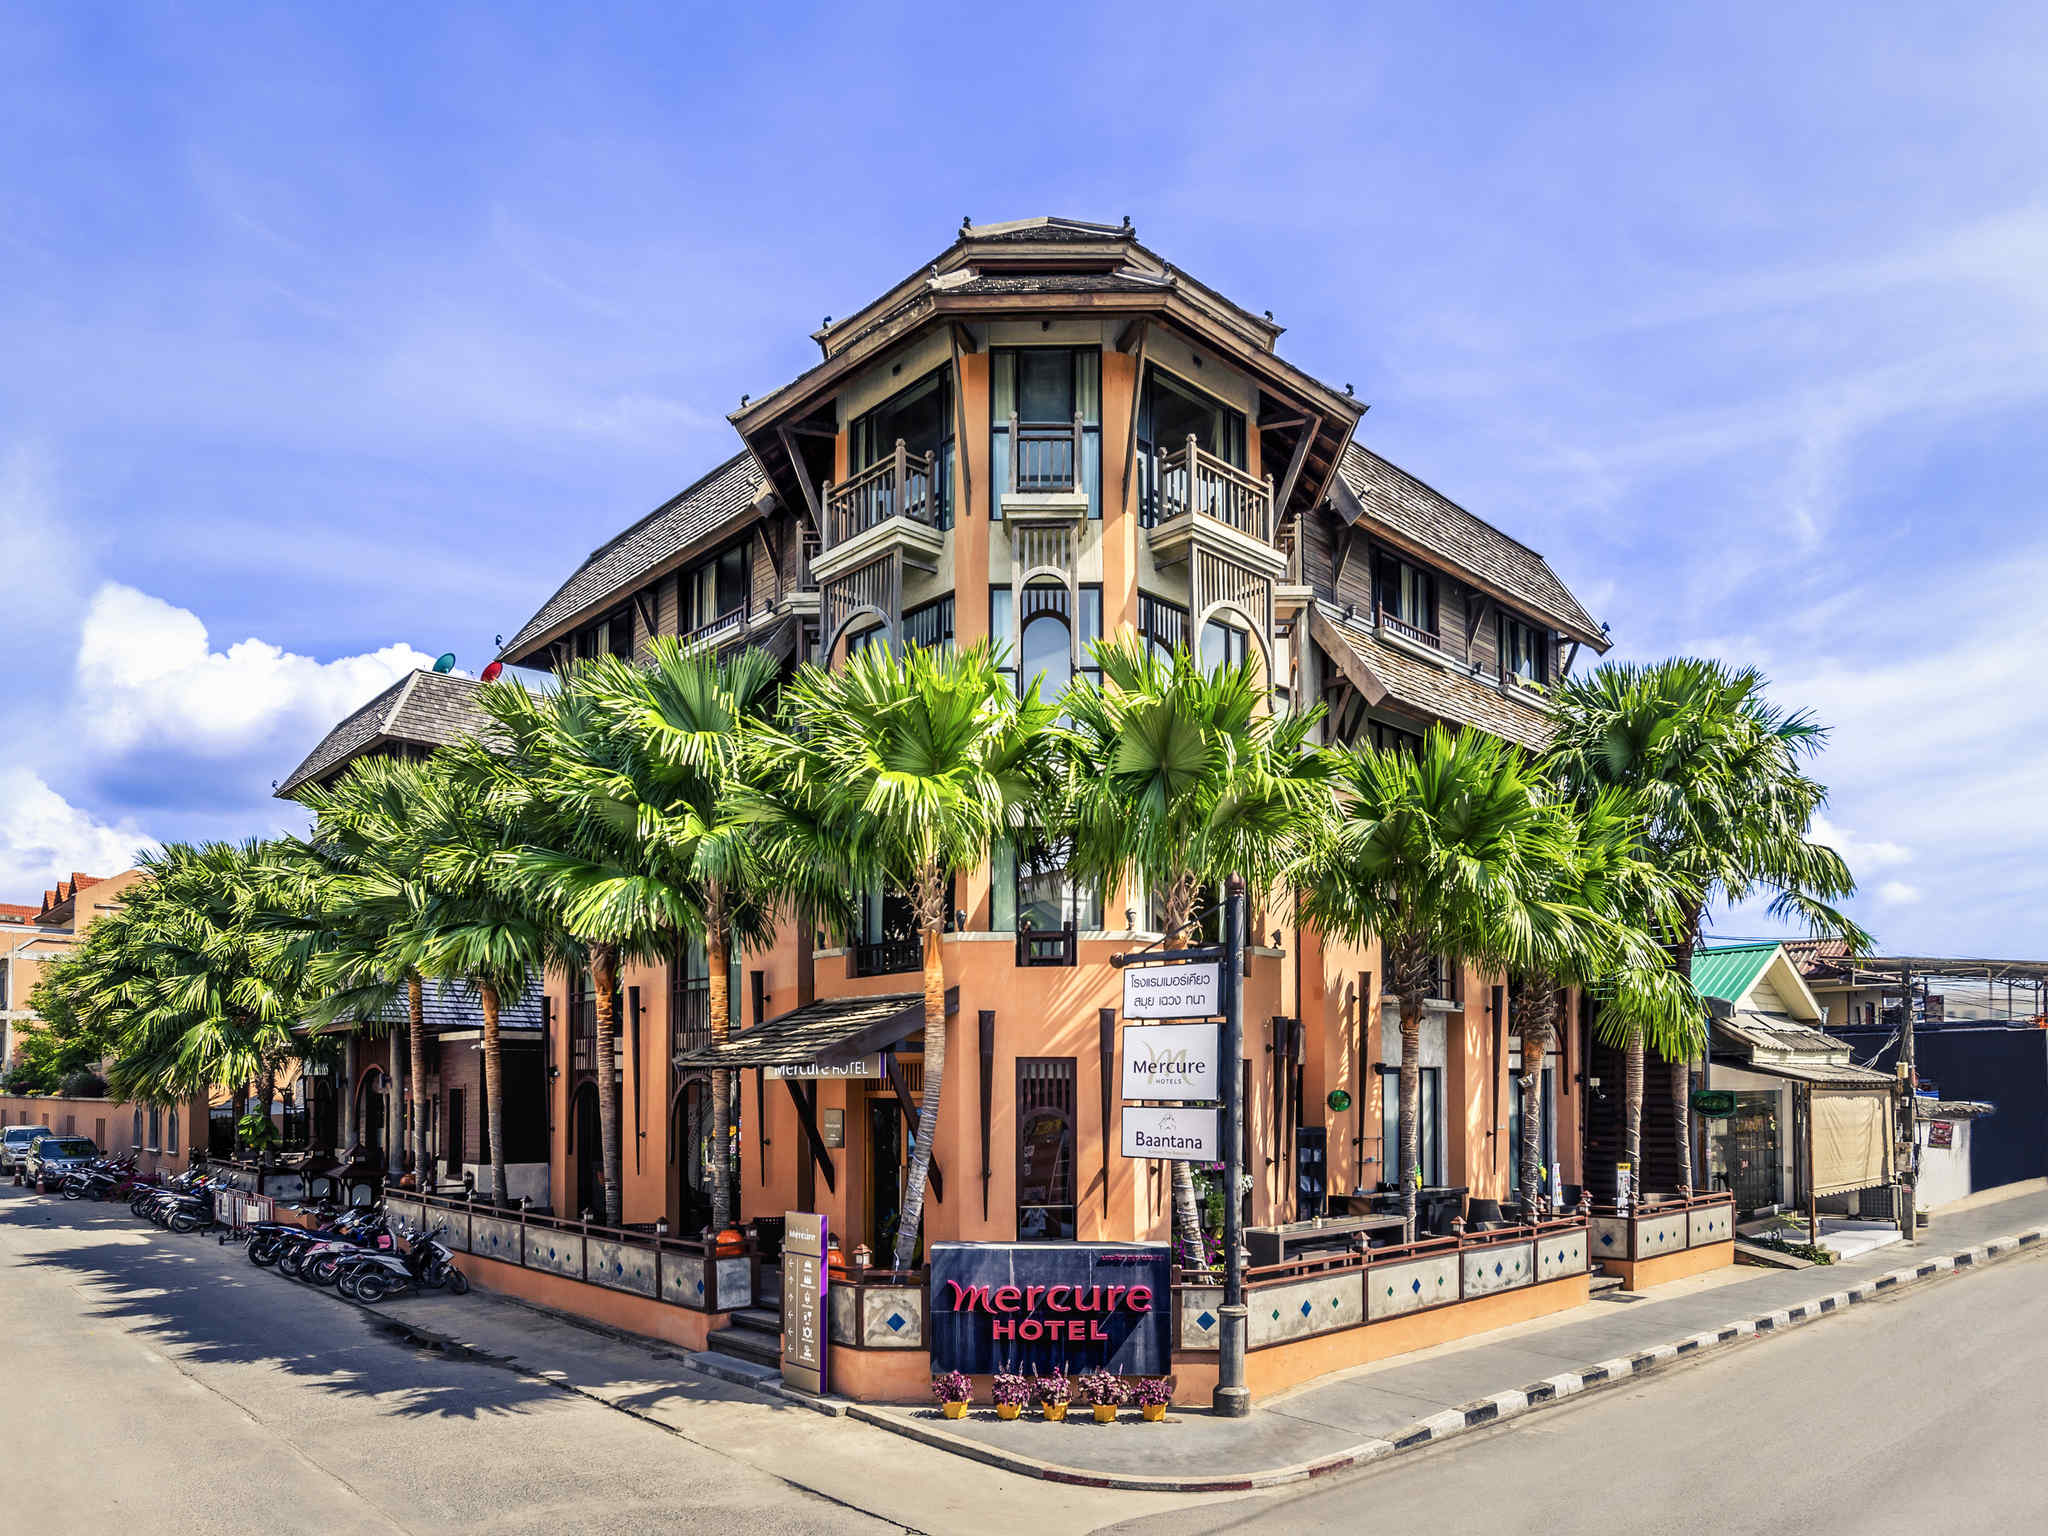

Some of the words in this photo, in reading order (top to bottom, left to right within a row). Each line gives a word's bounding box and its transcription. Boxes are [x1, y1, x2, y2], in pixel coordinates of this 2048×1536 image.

[1133, 1060, 1206, 1074] Mercure
[1135, 1131, 1202, 1150] Baantana
[992, 1319, 1108, 1341] HOTEL
